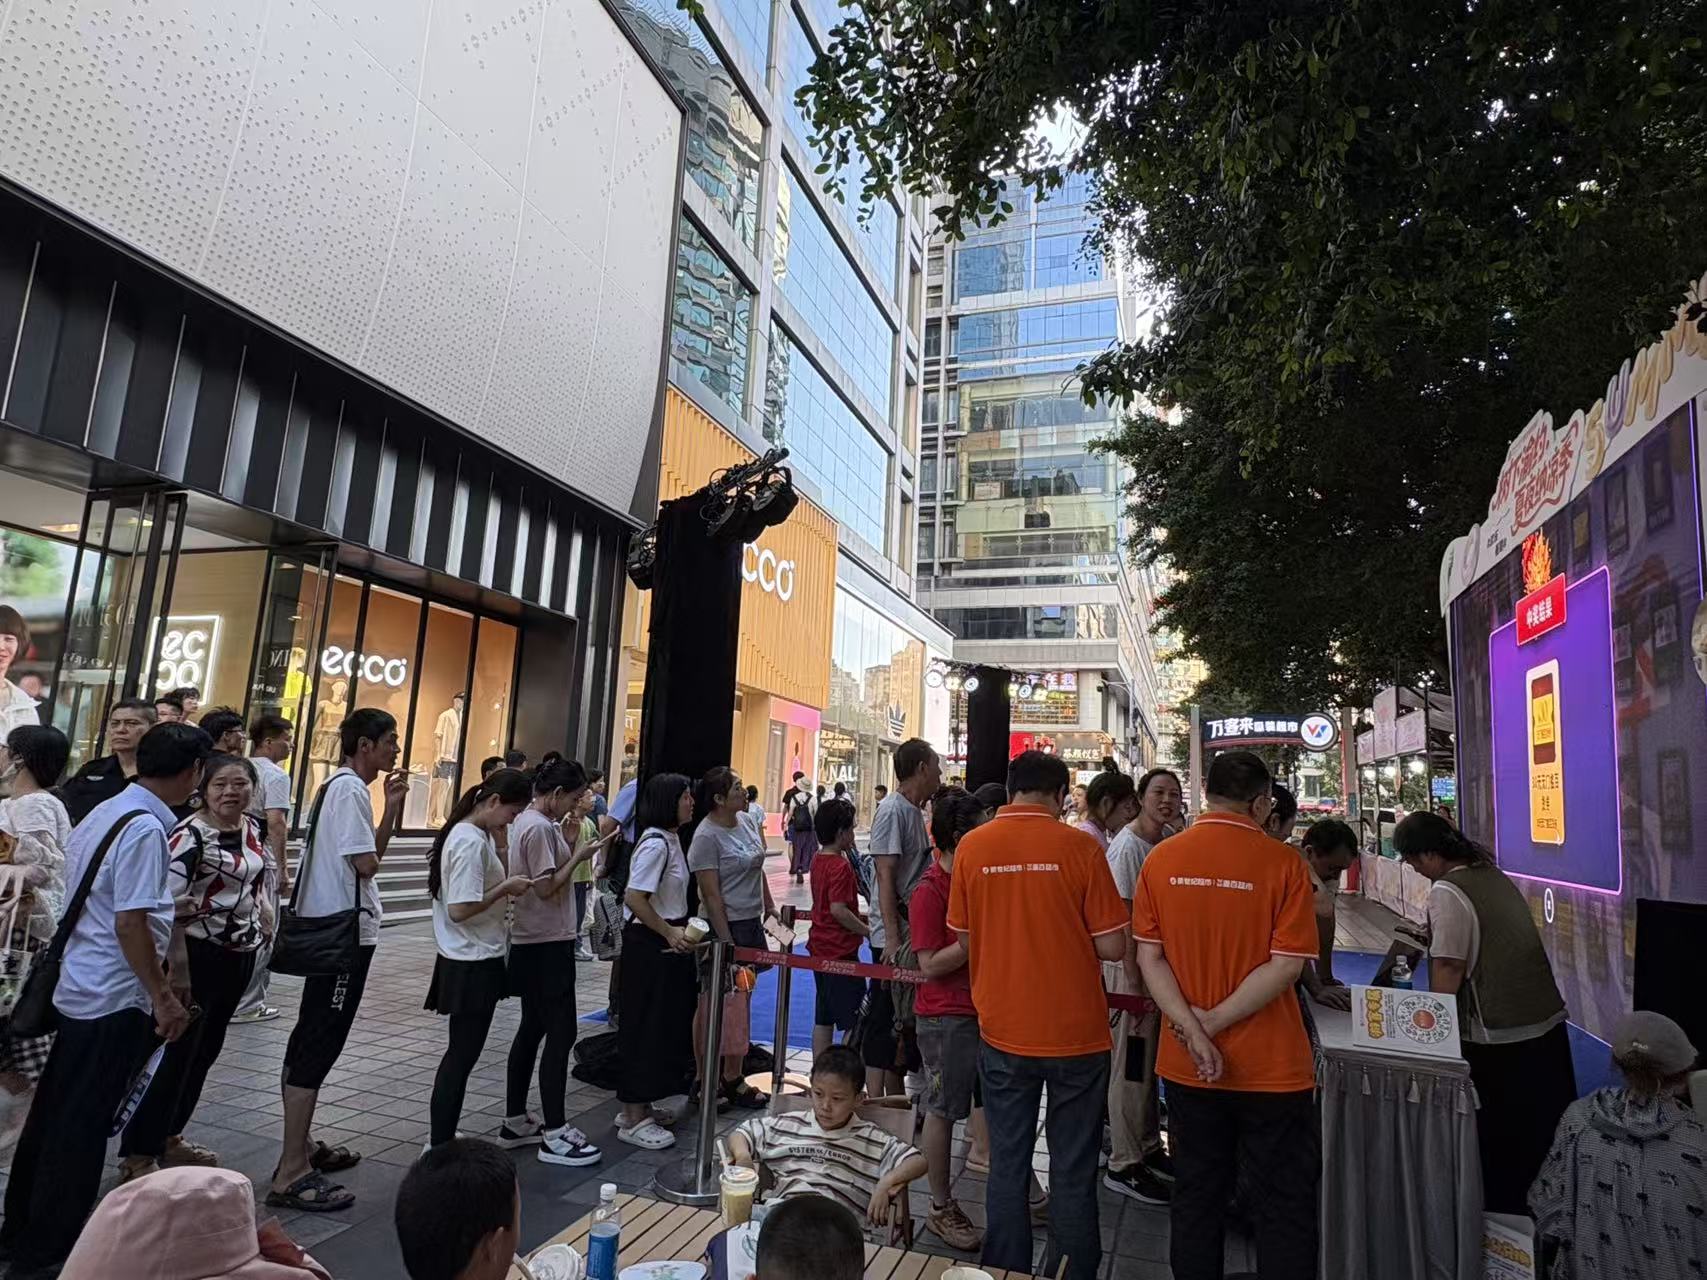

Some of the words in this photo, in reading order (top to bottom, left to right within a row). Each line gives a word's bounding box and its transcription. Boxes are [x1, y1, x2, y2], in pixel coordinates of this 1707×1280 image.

[742, 541, 795, 601] cco
[1526, 596, 1553, 627] 中奖结果
[321, 645, 408, 687] ecco
